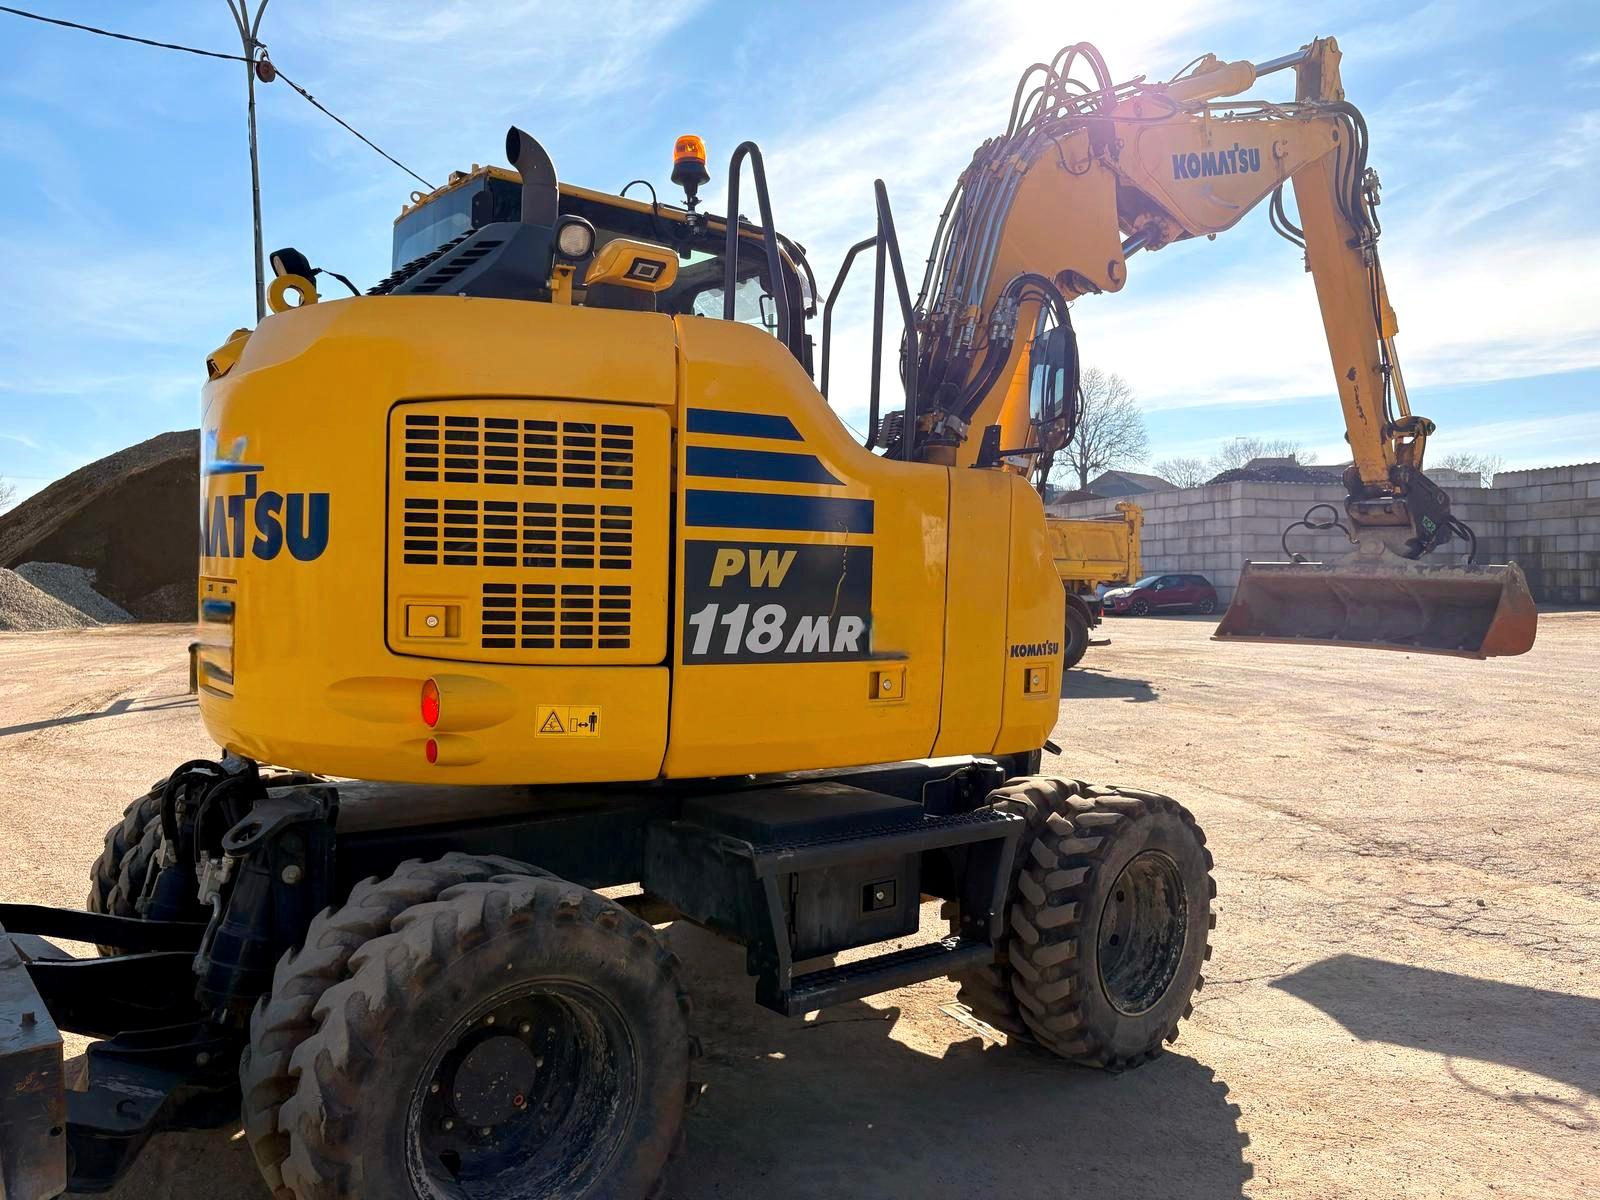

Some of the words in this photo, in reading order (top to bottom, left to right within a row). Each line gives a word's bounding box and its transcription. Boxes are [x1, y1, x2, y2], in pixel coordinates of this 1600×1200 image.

[1172, 143, 1261, 180] KOMATSU
[709, 548, 798, 588] PW
[1010, 640, 1059, 658] KOMATSU
